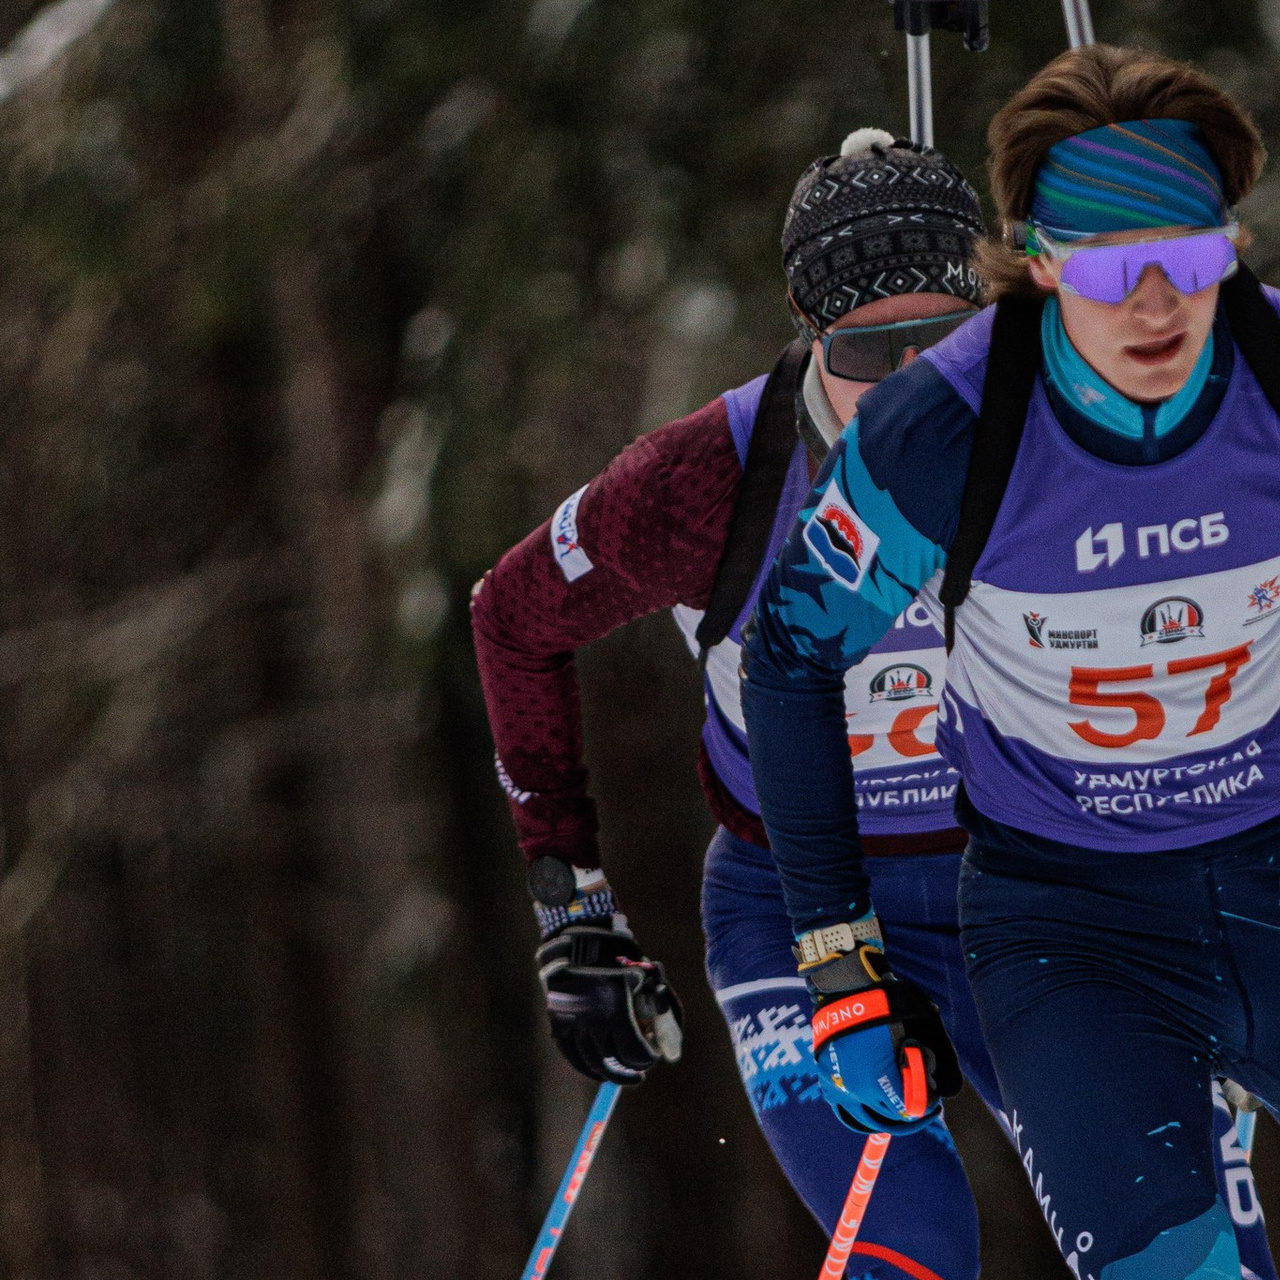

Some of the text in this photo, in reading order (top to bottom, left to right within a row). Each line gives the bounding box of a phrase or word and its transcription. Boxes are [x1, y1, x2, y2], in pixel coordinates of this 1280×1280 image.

[1137, 511, 1230, 558] ПСБ
[1048, 629, 1098, 639] МИНСПОРТ
[1049, 639, 1099, 649] УДМУРТИИ
[1067, 639, 1254, 748] 57
[812, 1002, 866, 1037] ONE/WA
